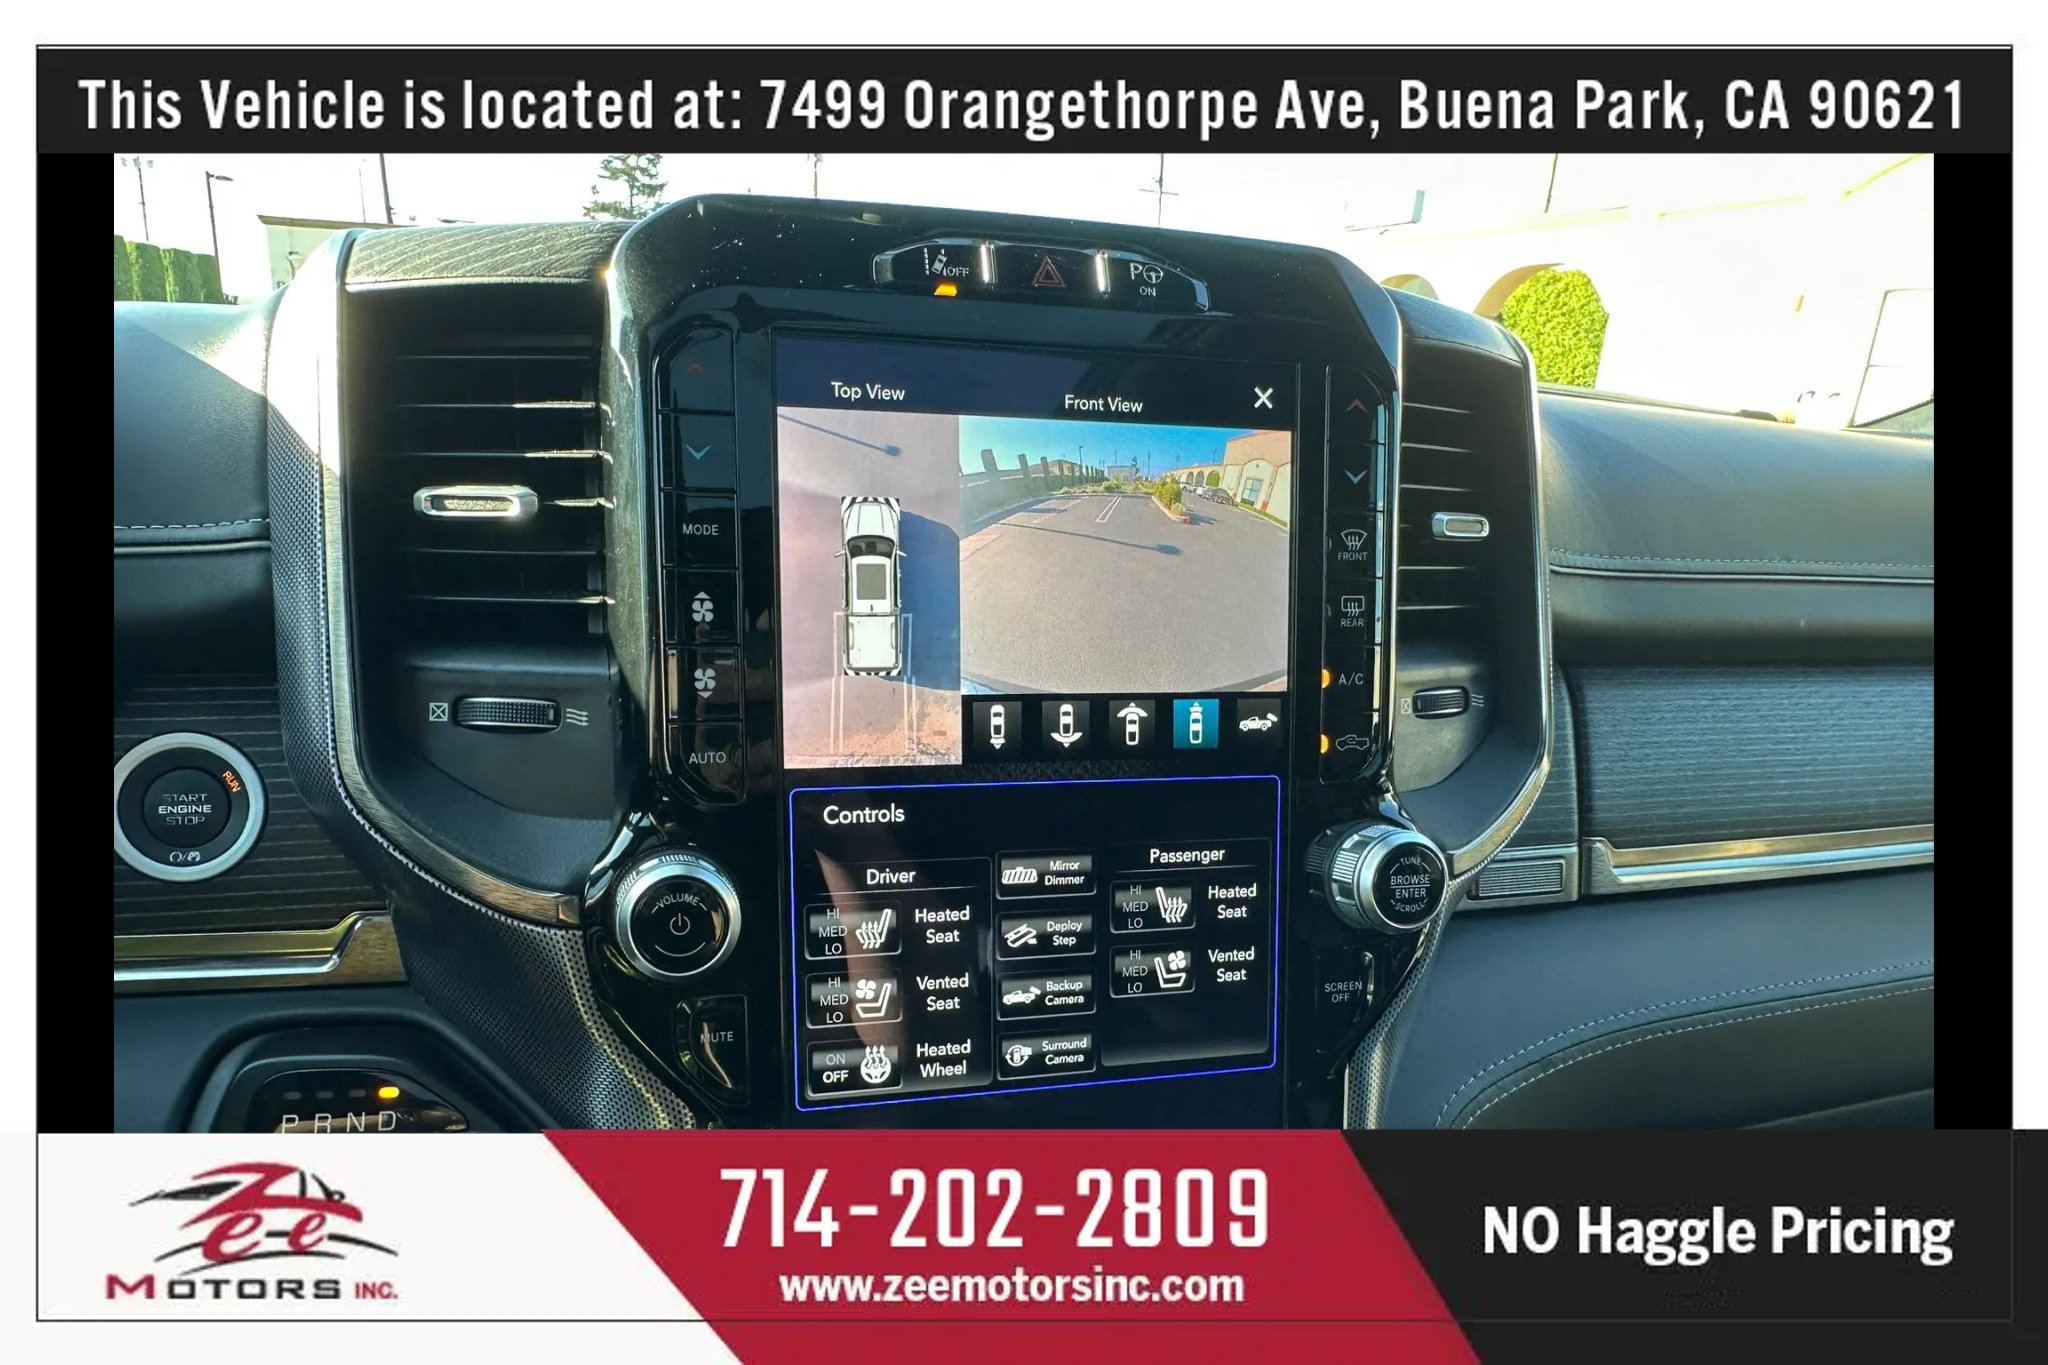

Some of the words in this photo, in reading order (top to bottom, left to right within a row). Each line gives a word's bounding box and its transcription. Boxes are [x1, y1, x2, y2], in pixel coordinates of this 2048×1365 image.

[947, 266, 970, 278] OFF
[1139, 286, 1157, 297] ON
[831, 381, 862, 402] Top
[866, 383, 906, 402] View
[1064, 394, 1105, 412] Front
[1108, 396, 1143, 414] View
[682, 523, 719, 536] MODE
[1337, 551, 1368, 562] FRONT
[1340, 618, 1364, 628] REAR
[1338, 672, 1364, 686] A/C
[689, 751, 727, 765] AUTO
[222, 770, 242, 793] RUN
[162, 793, 208, 802] START
[158, 804, 213, 815] ENGINE
[823, 802, 905, 825] Controls
[166, 816, 205, 826] STOP
[1149, 848, 1226, 865] Passenger
[1400, 856, 1423, 867] TUNE
[1049, 860, 1081, 871] Mirror
[866, 868, 916, 885] Driver
[1044, 875, 1085, 886] Dimmer
[1390, 874, 1431, 886] BROWSE
[1130, 884, 1142, 896] HI
[1208, 882, 1257, 899] Heated
[1395, 888, 1427, 899] ENTER
[655, 892, 701, 909] VOLUME
[1122, 901, 1149, 913] MED
[1217, 904, 1248, 919] Seat
[1394, 901, 1426, 913] SCROLL
[826, 908, 840, 920] HI
[914, 905, 970, 923] Heated
[1046, 920, 1083, 933] Deploy
[1128, 917, 1143, 929] LO
[818, 925, 848, 938] MED
[926, 928, 960, 944] Seat
[1052, 935, 1077, 947] Step
[825, 943, 843, 955] LO
[1130, 949, 1142, 961] HI
[1208, 946, 1255, 963] Vented
[1122, 965, 1149, 977] MED
[1216, 968, 1247, 983] Seat
[828, 976, 841, 988] HI
[915, 972, 970, 990] Vented
[1046, 979, 1083, 992] Backup
[1324, 981, 1363, 993] SCREEN
[1127, 982, 1143, 993] LO
[820, 994, 849, 1006] MED
[926, 996, 961, 1011] Seat
[1044, 995, 1085, 1006] Camera
[1331, 992, 1350, 1003] OFF
[826, 1011, 844, 1024] LO
[700, 1030, 734, 1043] MUTE
[916, 1038, 971, 1058] Heated
[1042, 1037, 1087, 1051] Surround
[825, 1053, 846, 1065] ON
[1044, 1054, 1085, 1065] Camera
[919, 1059, 967, 1078] Wheel
[822, 1069, 849, 1083] OFF
